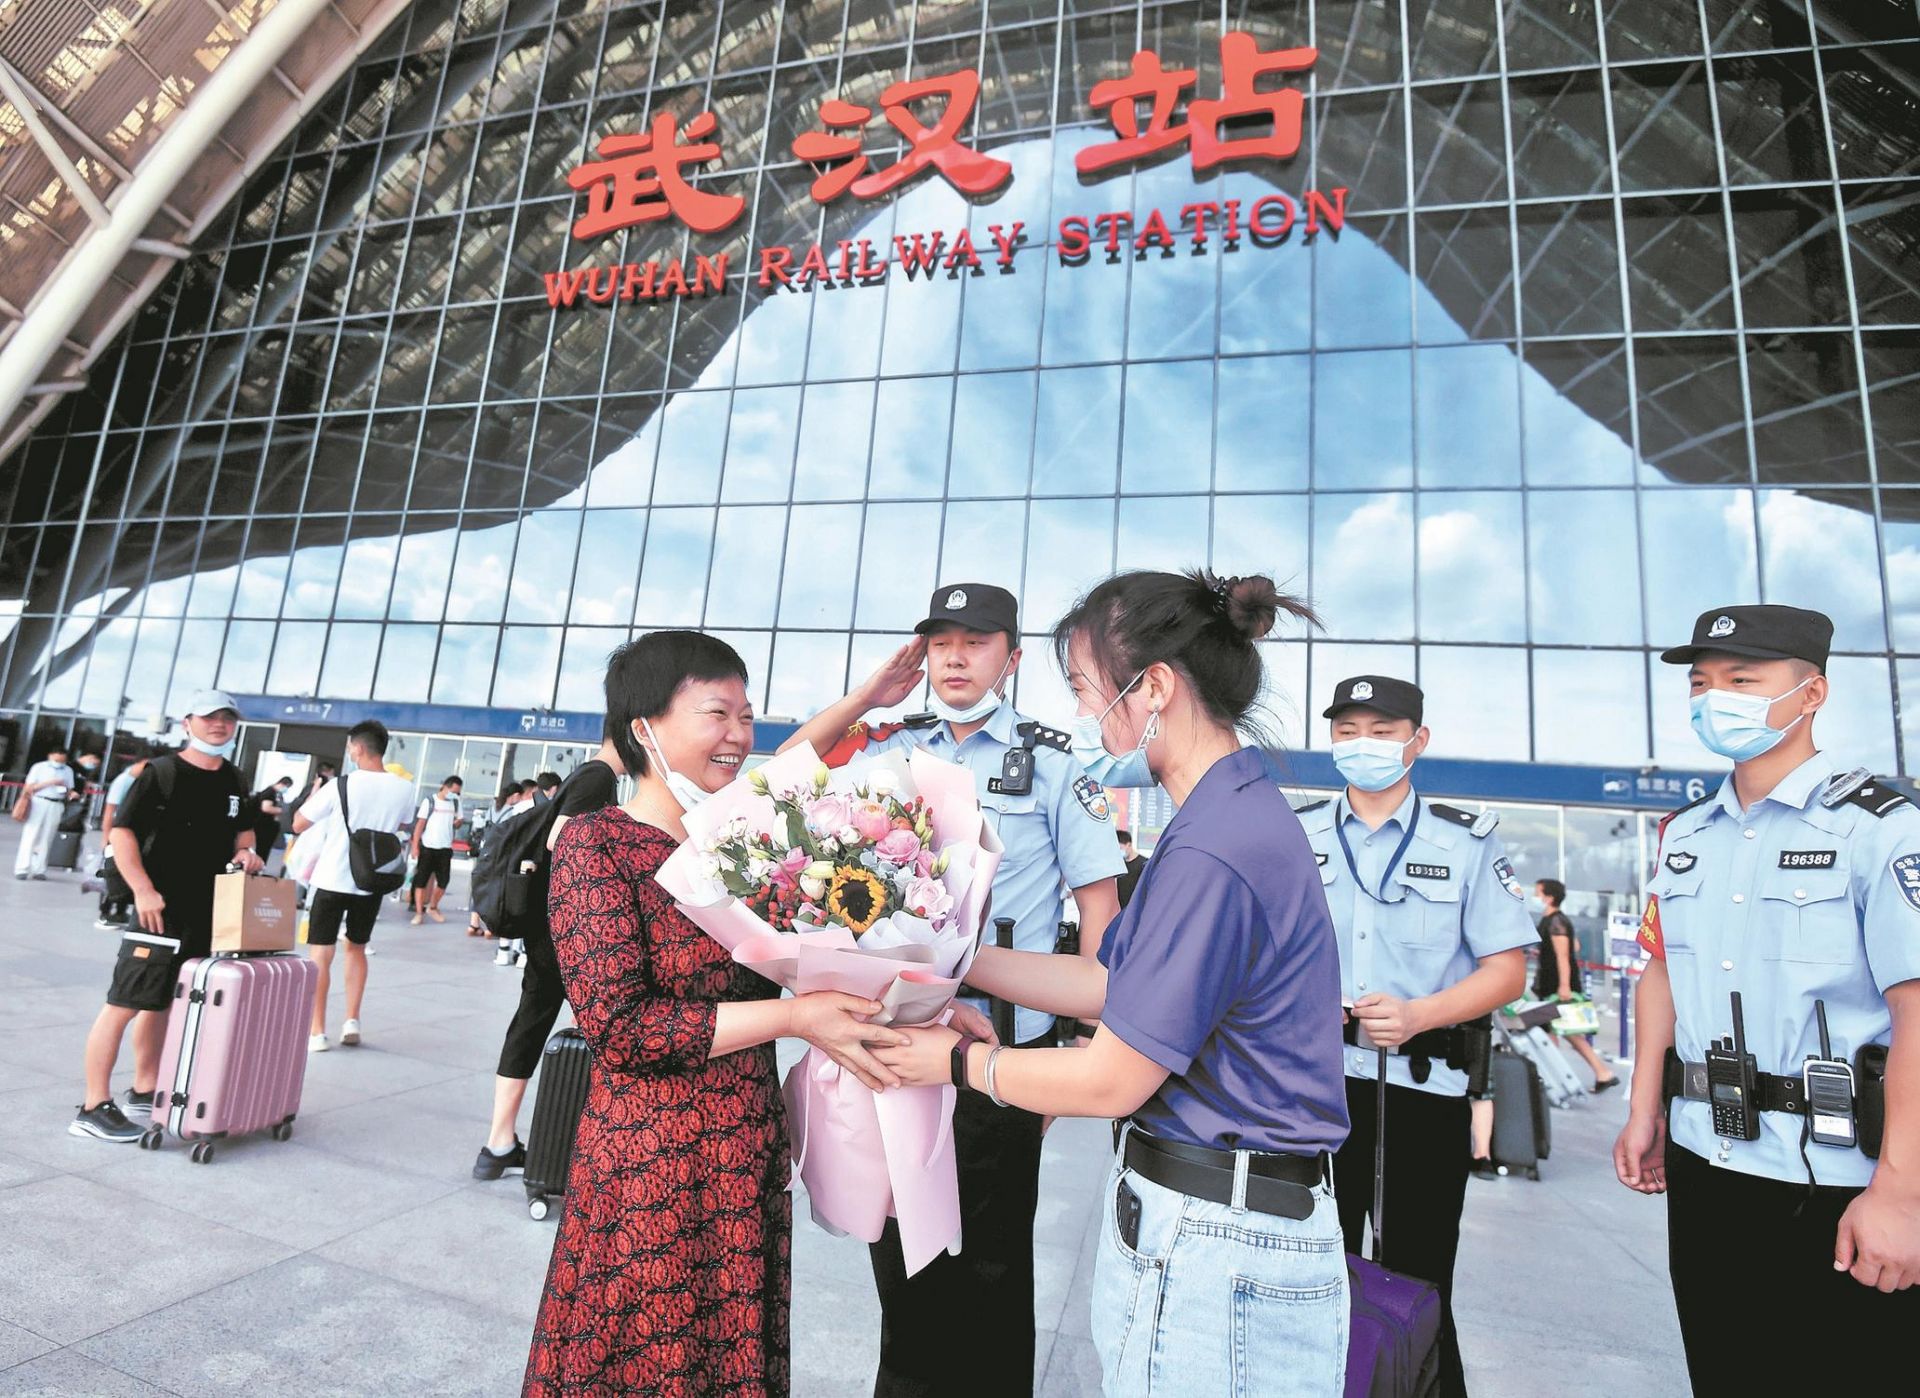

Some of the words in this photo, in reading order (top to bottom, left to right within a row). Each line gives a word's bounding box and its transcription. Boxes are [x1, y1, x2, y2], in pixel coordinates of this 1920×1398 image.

[568, 32, 1319, 239] 武汉站
[544, 254, 729, 309] WUHAN
[760, 223, 1024, 288] RAILWAY
[1057, 188, 1349, 258] STATION
[321, 703, 333, 720] 7
[1686, 778, 1706, 802] 6
[1782, 853, 1832, 866] 196388
